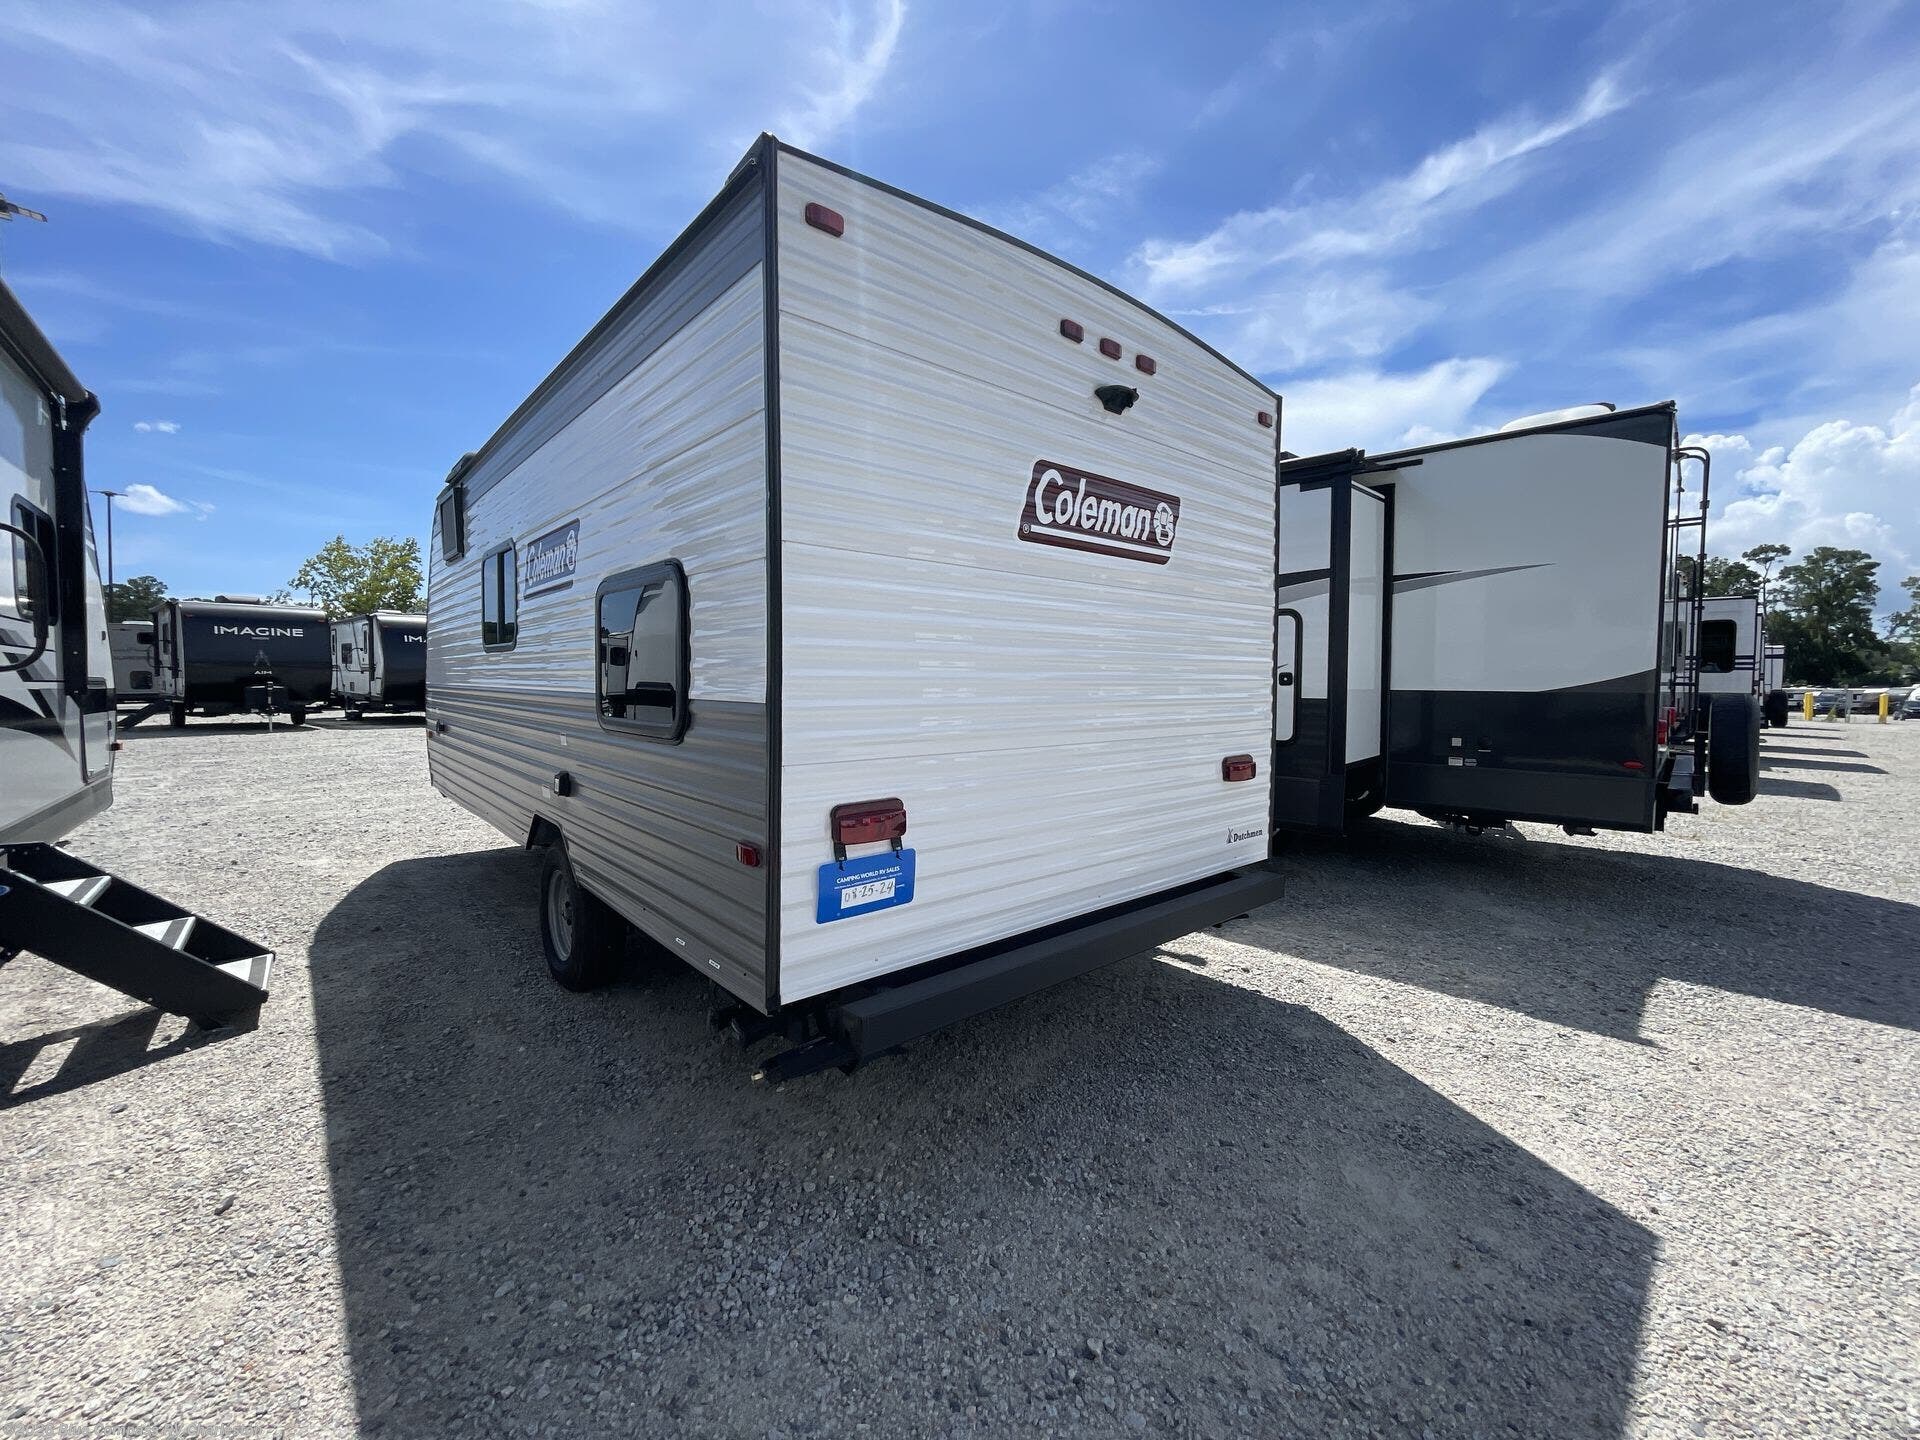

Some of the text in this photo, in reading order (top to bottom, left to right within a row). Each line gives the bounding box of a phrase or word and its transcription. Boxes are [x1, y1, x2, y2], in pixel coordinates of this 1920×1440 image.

[1034, 468, 1152, 541] Coleman
[526, 541, 567, 586] Coleman
[213, 625, 304, 637] IMAGINE
[403, 634, 427, 643] IM
[1233, 829, 1263, 843] Dutchmen
[836, 873, 861, 884] CAMPING
[860, 870, 879, 879] WORLD
[886, 865, 901, 874] SALES
